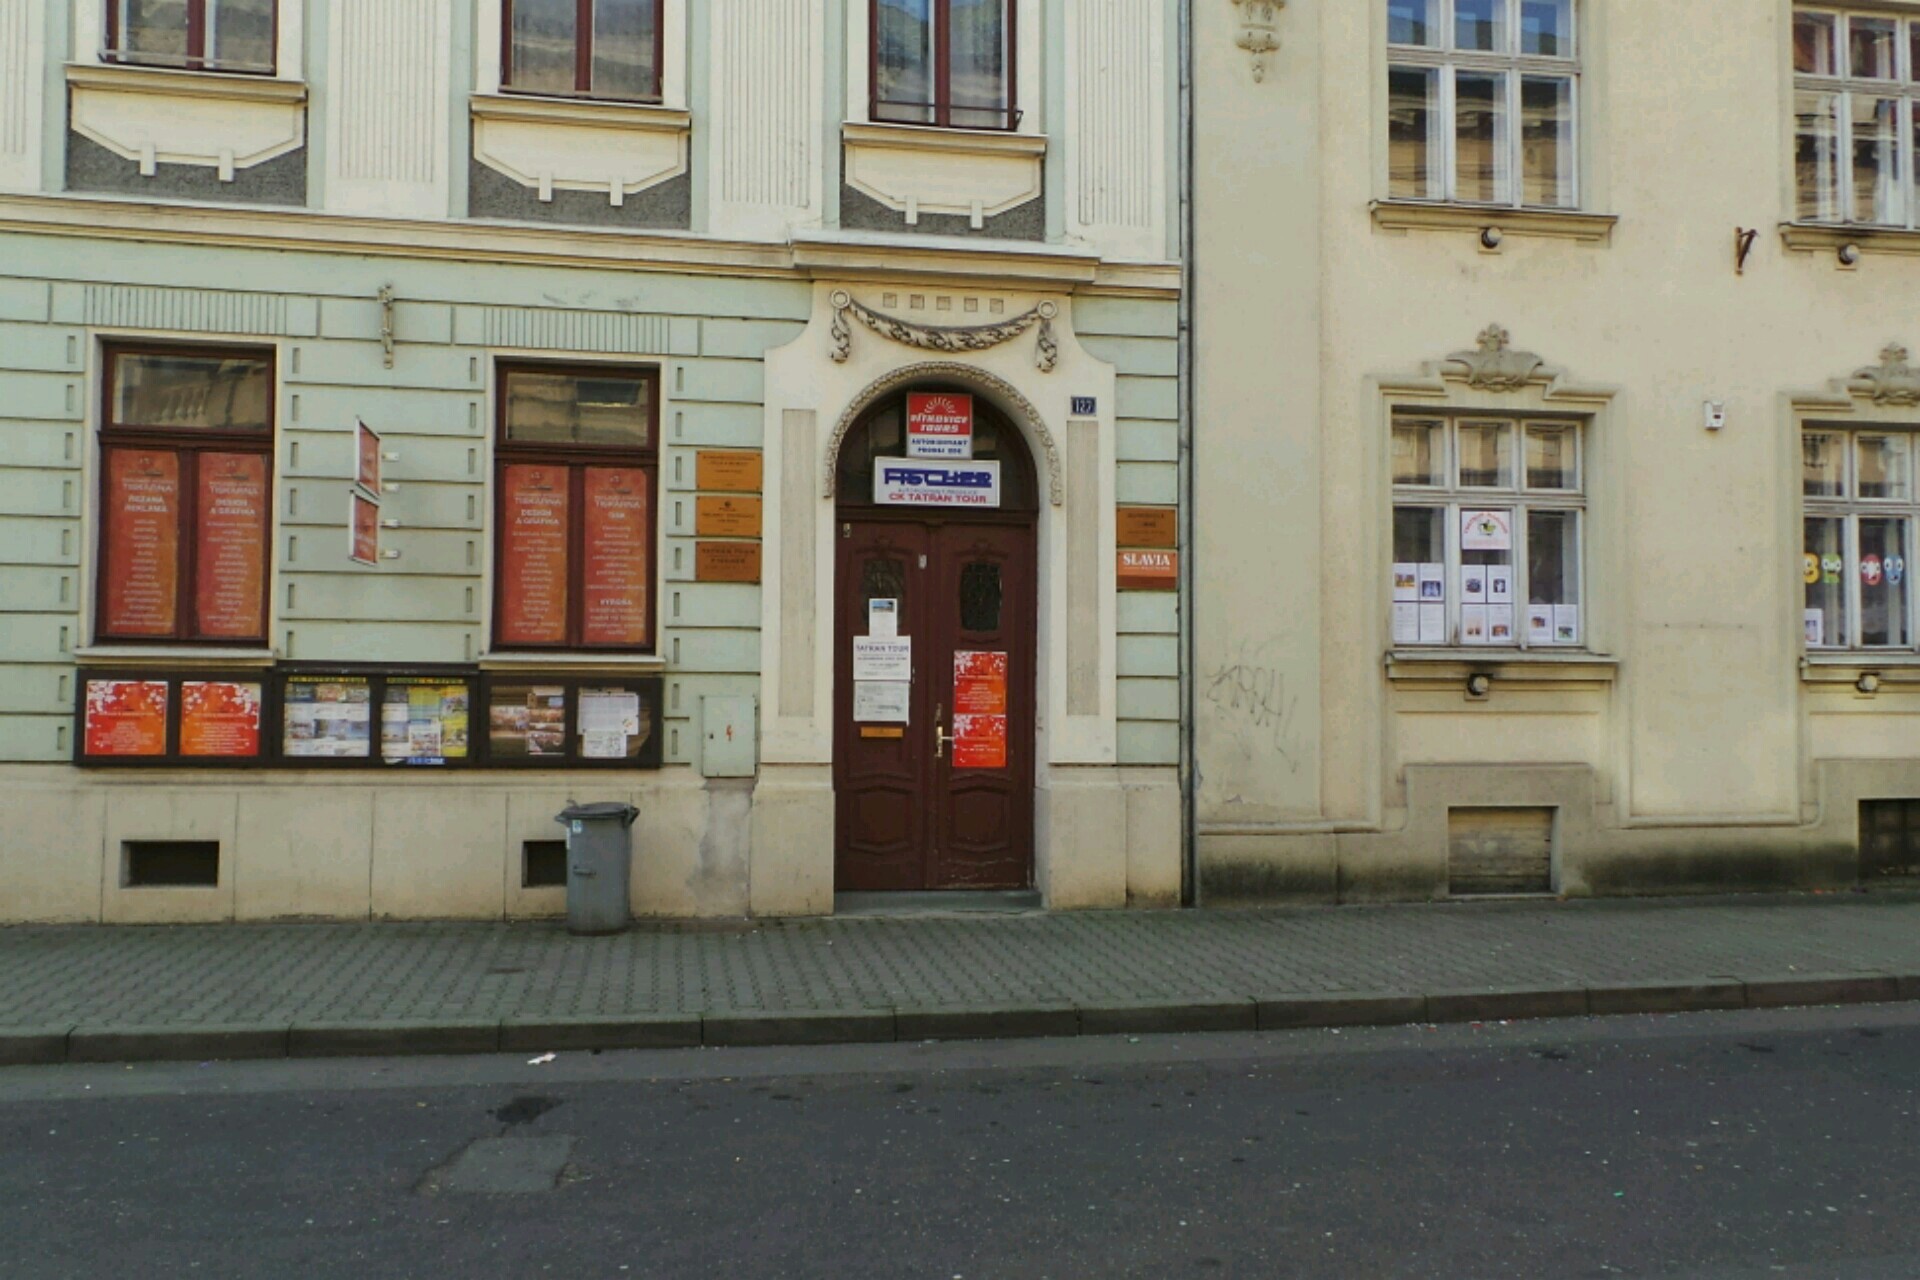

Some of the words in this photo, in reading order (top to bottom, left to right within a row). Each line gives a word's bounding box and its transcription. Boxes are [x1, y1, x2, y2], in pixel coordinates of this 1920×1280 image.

[884, 468, 993, 489] FISCHER
[889, 493, 905, 501] CK
[909, 494, 952, 502] TATRAN
[956, 495, 986, 503] TOUR
[1123, 552, 1170, 566] SLAVIA
